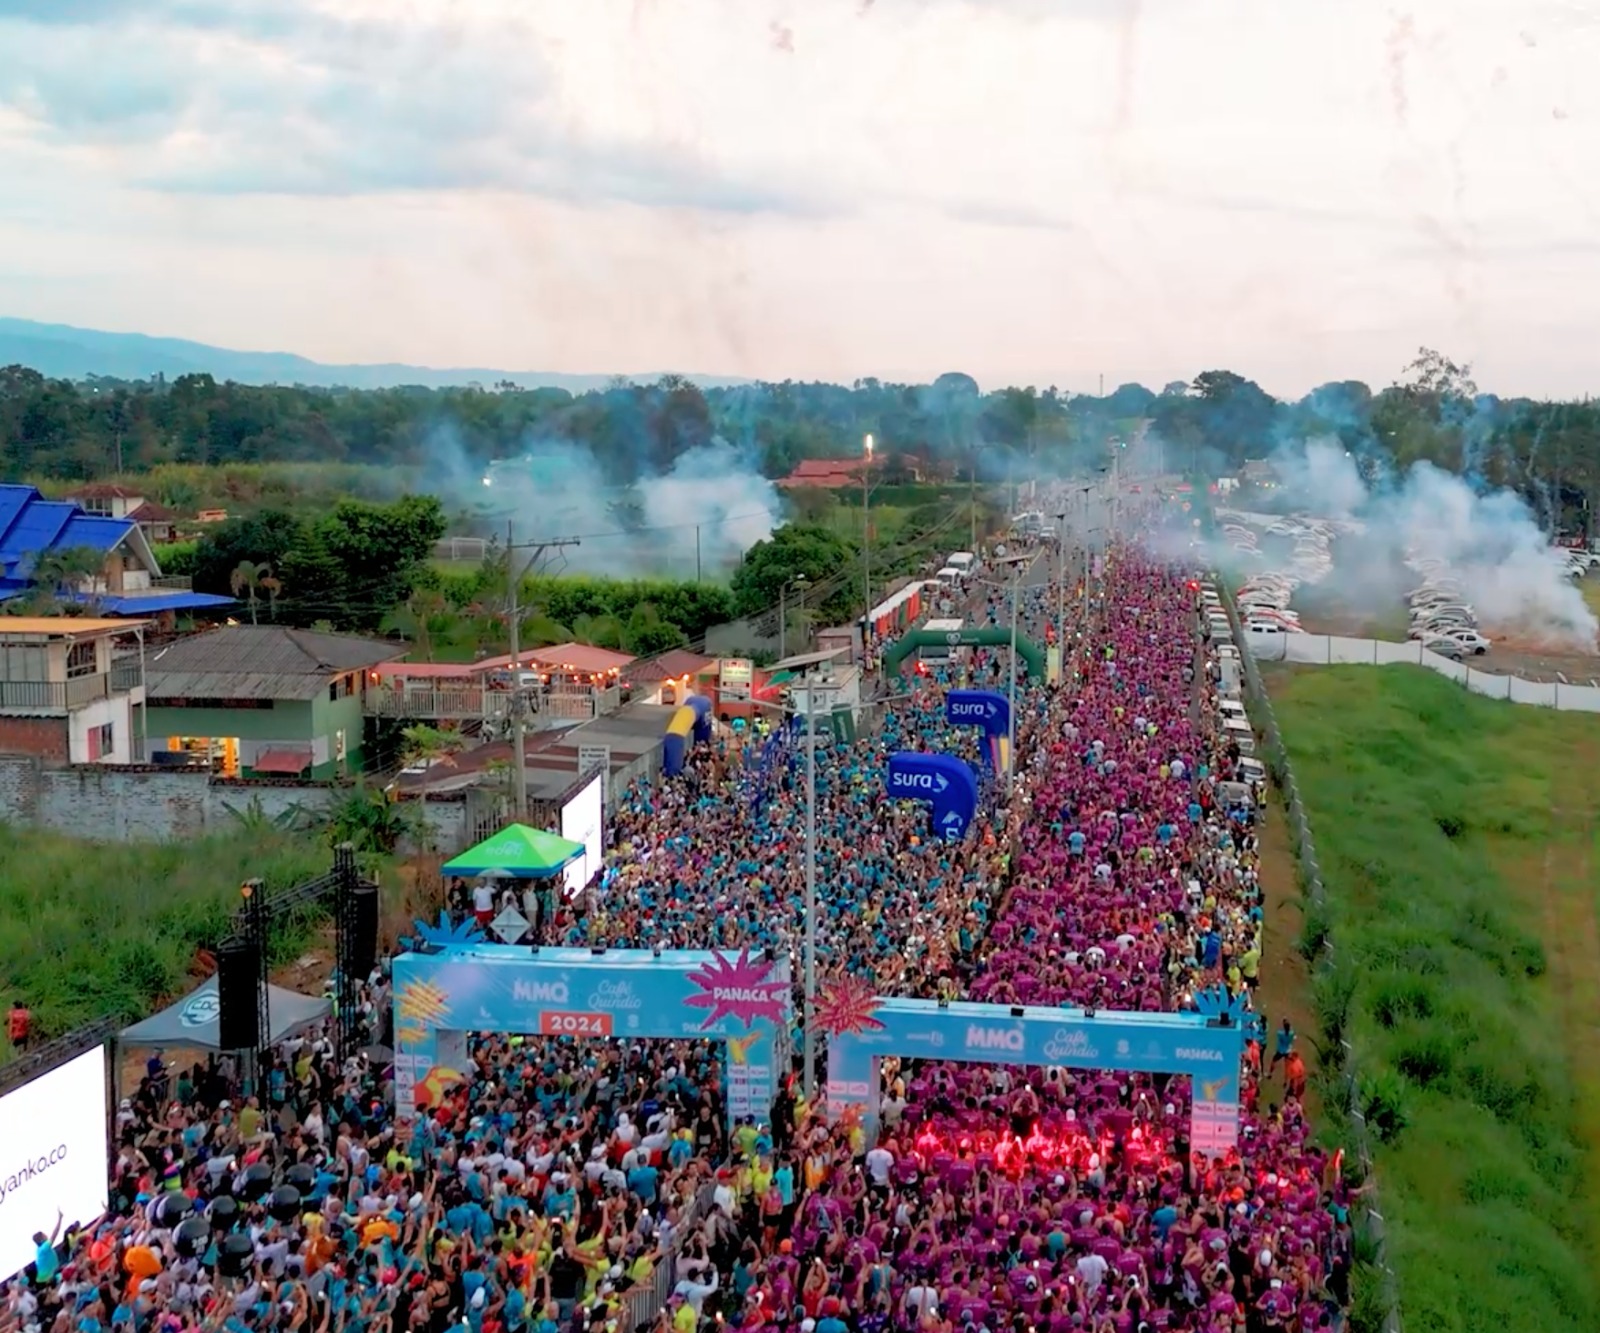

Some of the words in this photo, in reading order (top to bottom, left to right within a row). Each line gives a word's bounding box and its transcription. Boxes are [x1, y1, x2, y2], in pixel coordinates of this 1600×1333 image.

[951, 702, 984, 716] sura
[892, 771, 933, 789] sura
[513, 979, 569, 1004] MMQ
[598, 979, 632, 999] Café
[713, 987, 769, 1002] PANACA
[588, 993, 641, 1012] Quindío
[551, 1015, 603, 1034] 2024
[681, 1022, 726, 1034] PACA
[966, 1025, 1025, 1050] MMQ
[1054, 1028, 1090, 1046] Café
[1043, 1040, 1099, 1060] Quindío
[0, 1143, 67, 1204] yanko.co
